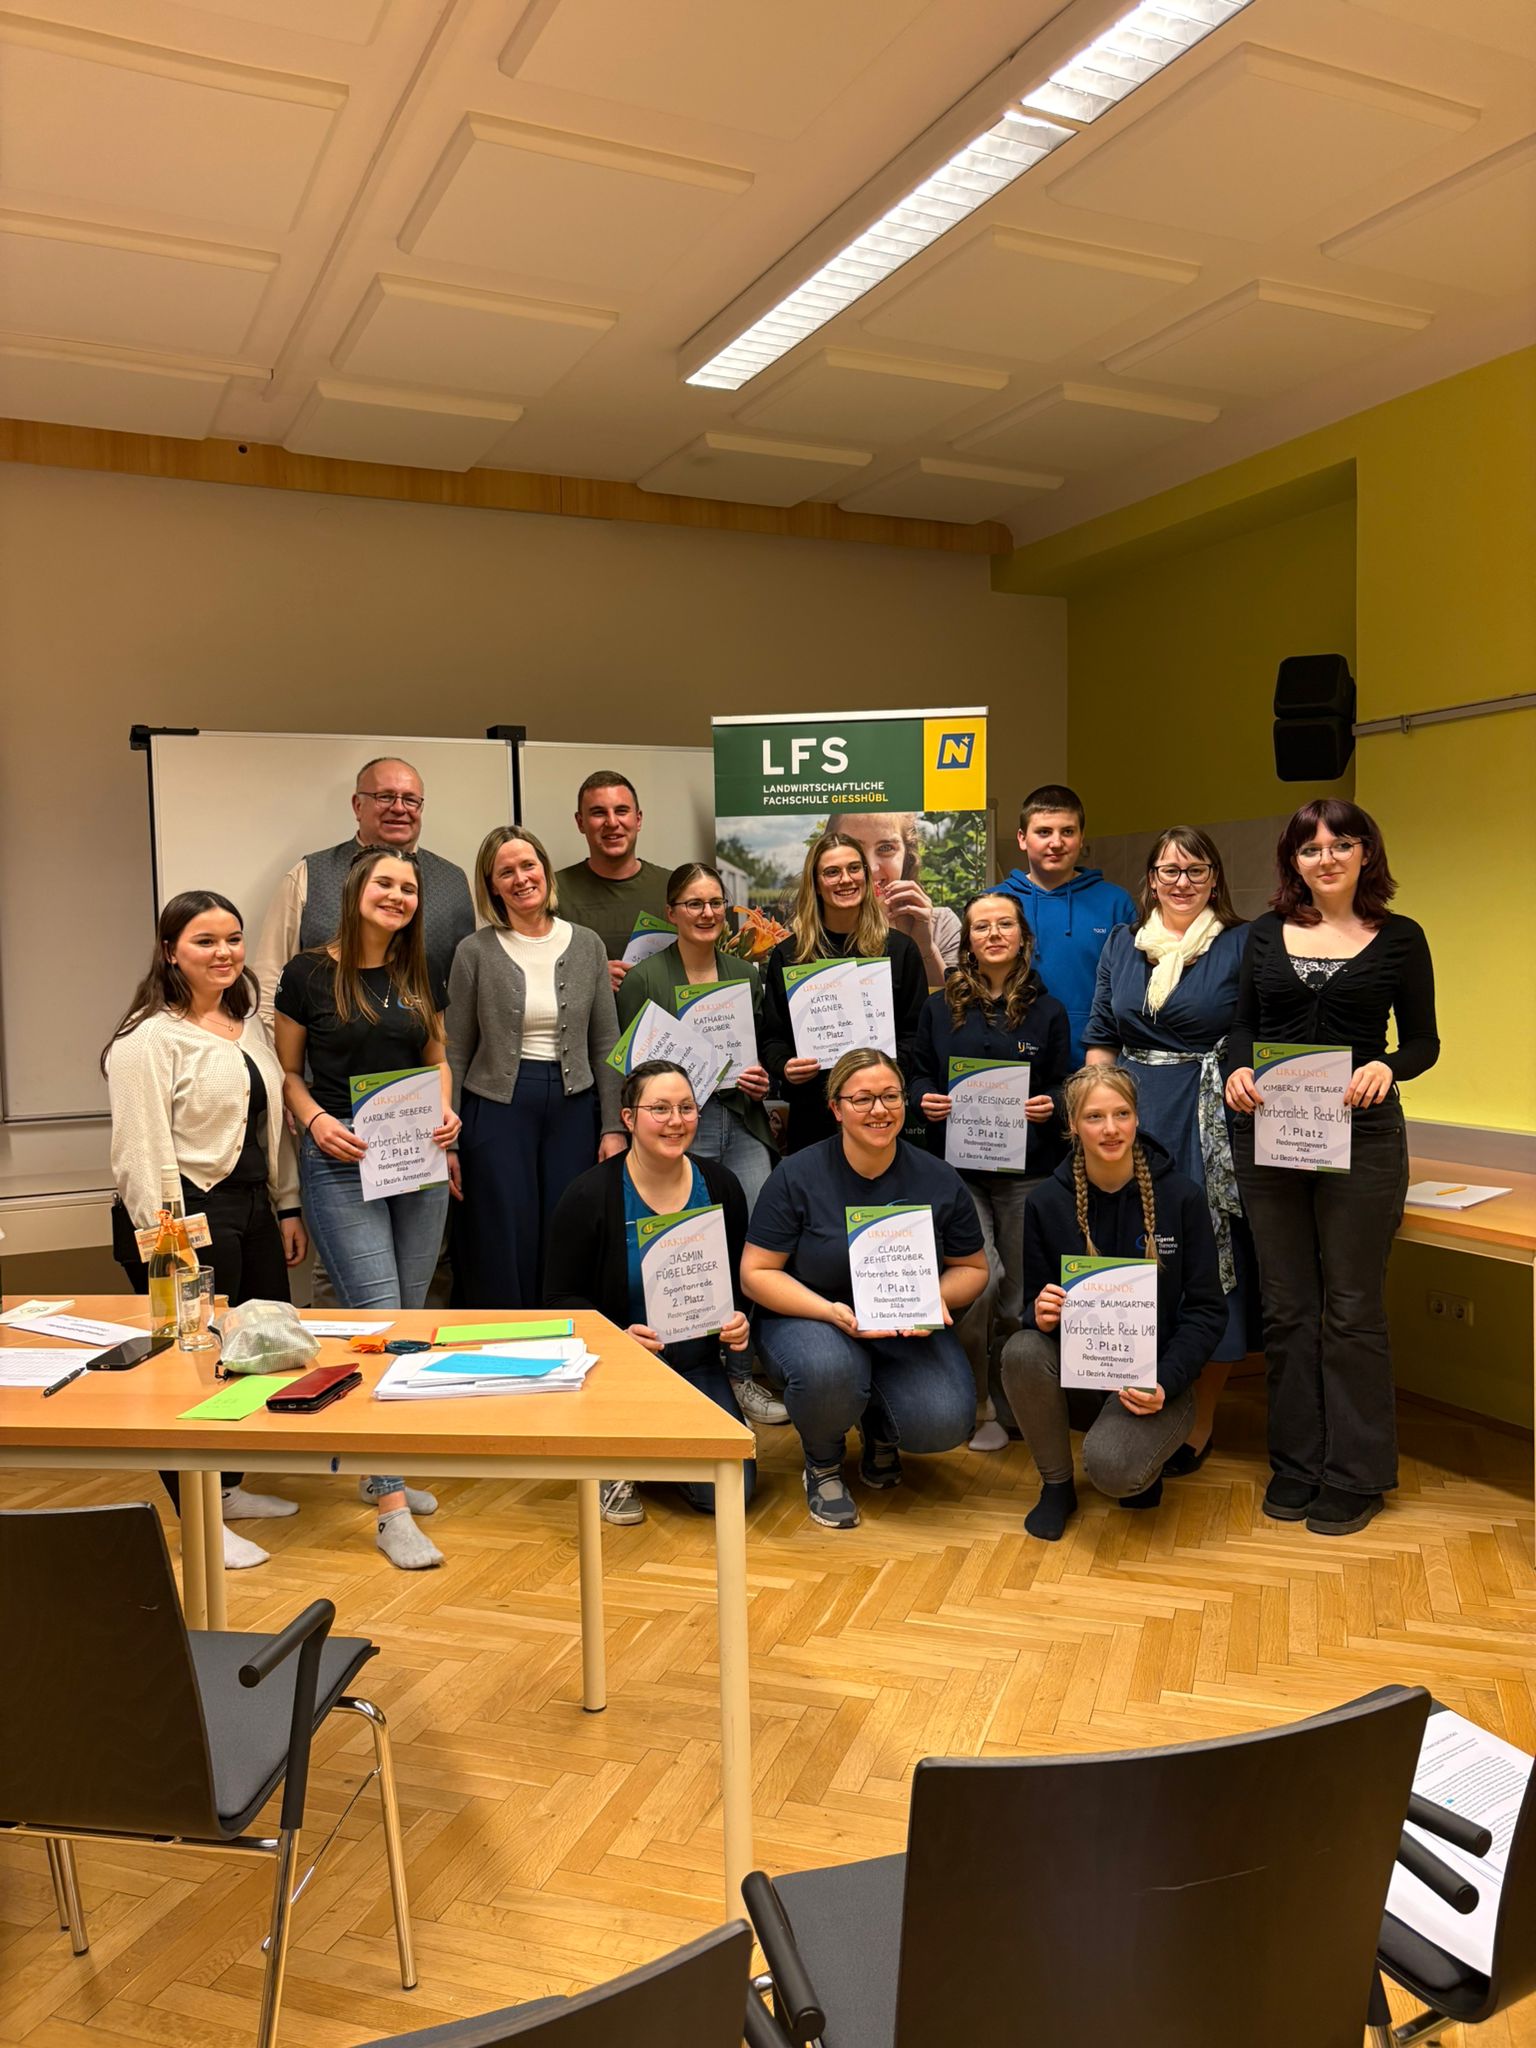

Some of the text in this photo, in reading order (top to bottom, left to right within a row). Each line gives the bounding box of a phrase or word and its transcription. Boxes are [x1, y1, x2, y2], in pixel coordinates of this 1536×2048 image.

[762, 737, 849, 775] LFS
[763, 781, 885, 794] LANDWIRTSCHAFTLICHE
[763, 792, 889, 805] FACHSCHULE GIESSHÜBL
[811, 994, 838, 1004] KATRIN
[695, 1001, 736, 1013] URKUNDE
[810, 1003, 844, 1015] WAGNER
[694, 1014, 735, 1025] KATHARINA
[702, 1023, 731, 1034] GRUBER
[807, 1024, 835, 1033] Nonsens
[827, 1031, 844, 1039] Platz
[727, 1040, 742, 1049] Rede
[1275, 1068, 1329, 1078] URKUNDE
[966, 1080, 1008, 1089] URKUNDE
[1263, 1084, 1344, 1093] KIMBERLY REITBAUER
[373, 1092, 423, 1106] URKUNDE
[956, 1094, 1021, 1106] LISA REISINGER
[363, 1105, 432, 1124] KAROLINE SIEBERER
[1259, 1104, 1309, 1120] Vorbereitete
[1314, 1106, 1335, 1122] Rede
[950, 1113, 992, 1126] Vorbereitete
[994, 1116, 1011, 1128] Rede
[416, 1127, 432, 1141] Rede
[979, 1129, 1004, 1139] Platz
[1293, 1127, 1324, 1139] Platz
[964, 1138, 1007, 1148] Redewettbewerb
[1276, 1139, 1327, 1149] Redewettbewerb
[392, 1146, 421, 1158] Platz
[378, 1157, 426, 1171] Redewettbewerb
[1301, 1157, 1332, 1165] Amstetten
[384, 1177, 401, 1185] Bezirk
[403, 1171, 432, 1181] Amstetten
[867, 1230, 913, 1239] URKUNDE
[878, 1245, 911, 1254] CLAUDIA
[669, 1250, 703, 1265] JASMIN
[864, 1254, 924, 1265] ZEHETGRUBER
[855, 1269, 899, 1279] Vorbereitete
[902, 1268, 918, 1277] Rede
[663, 1279, 713, 1297] Spontanrede
[888, 1284, 916, 1293] Platz
[1083, 1282, 1134, 1293] URKUNDE
[684, 1294, 705, 1305] Platz
[1064, 1299, 1156, 1309] SIMONE BAUMGARTNER
[667, 1305, 716, 1319] Redewettbewerb
[673, 1325, 690, 1335] Bezirk
[1064, 1319, 1115, 1336] Vorbereitete
[1118, 1322, 1138, 1336] Rede
[1099, 1341, 1129, 1352] Platz
[1082, 1353, 1134, 1363] Redewettbewerb
[1086, 1370, 1105, 1378] Bezirk
[1107, 1371, 1140, 1380] Amstetten
